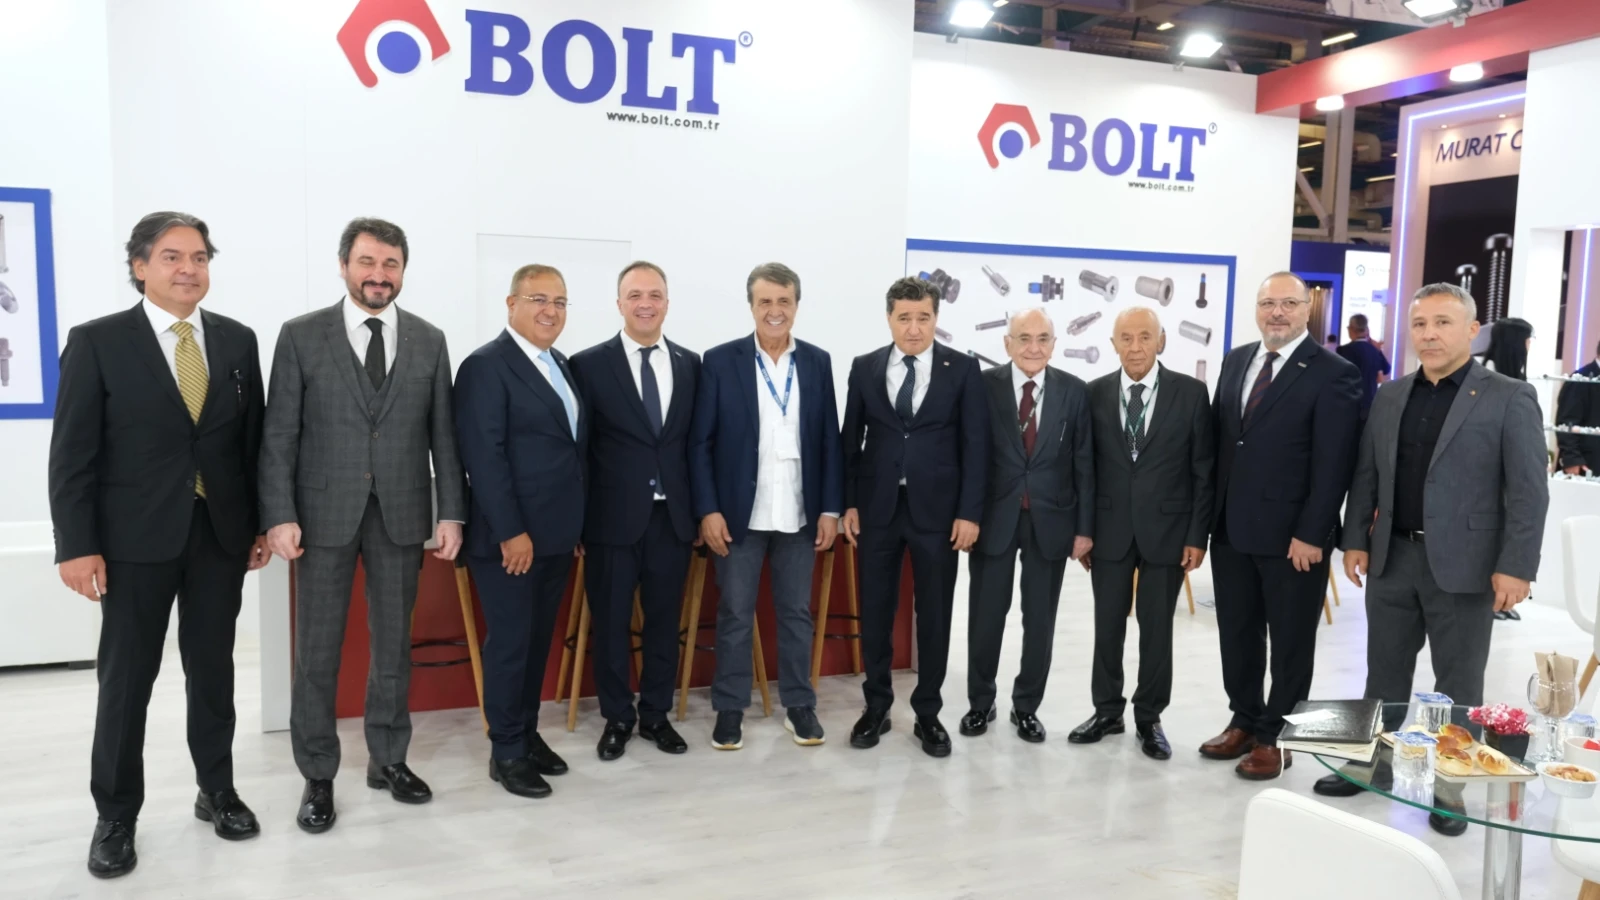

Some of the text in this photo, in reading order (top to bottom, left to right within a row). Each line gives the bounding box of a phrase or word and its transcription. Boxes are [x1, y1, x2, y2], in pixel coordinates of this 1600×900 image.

[465, 9, 736, 115] BOLT
[606, 112, 720, 130] www.bolt.com.tr
[1048, 112, 1206, 182] BOLT
[1436, 133, 1507, 163] MURAT
[1128, 181, 1195, 192] www.bolt.com.tr
